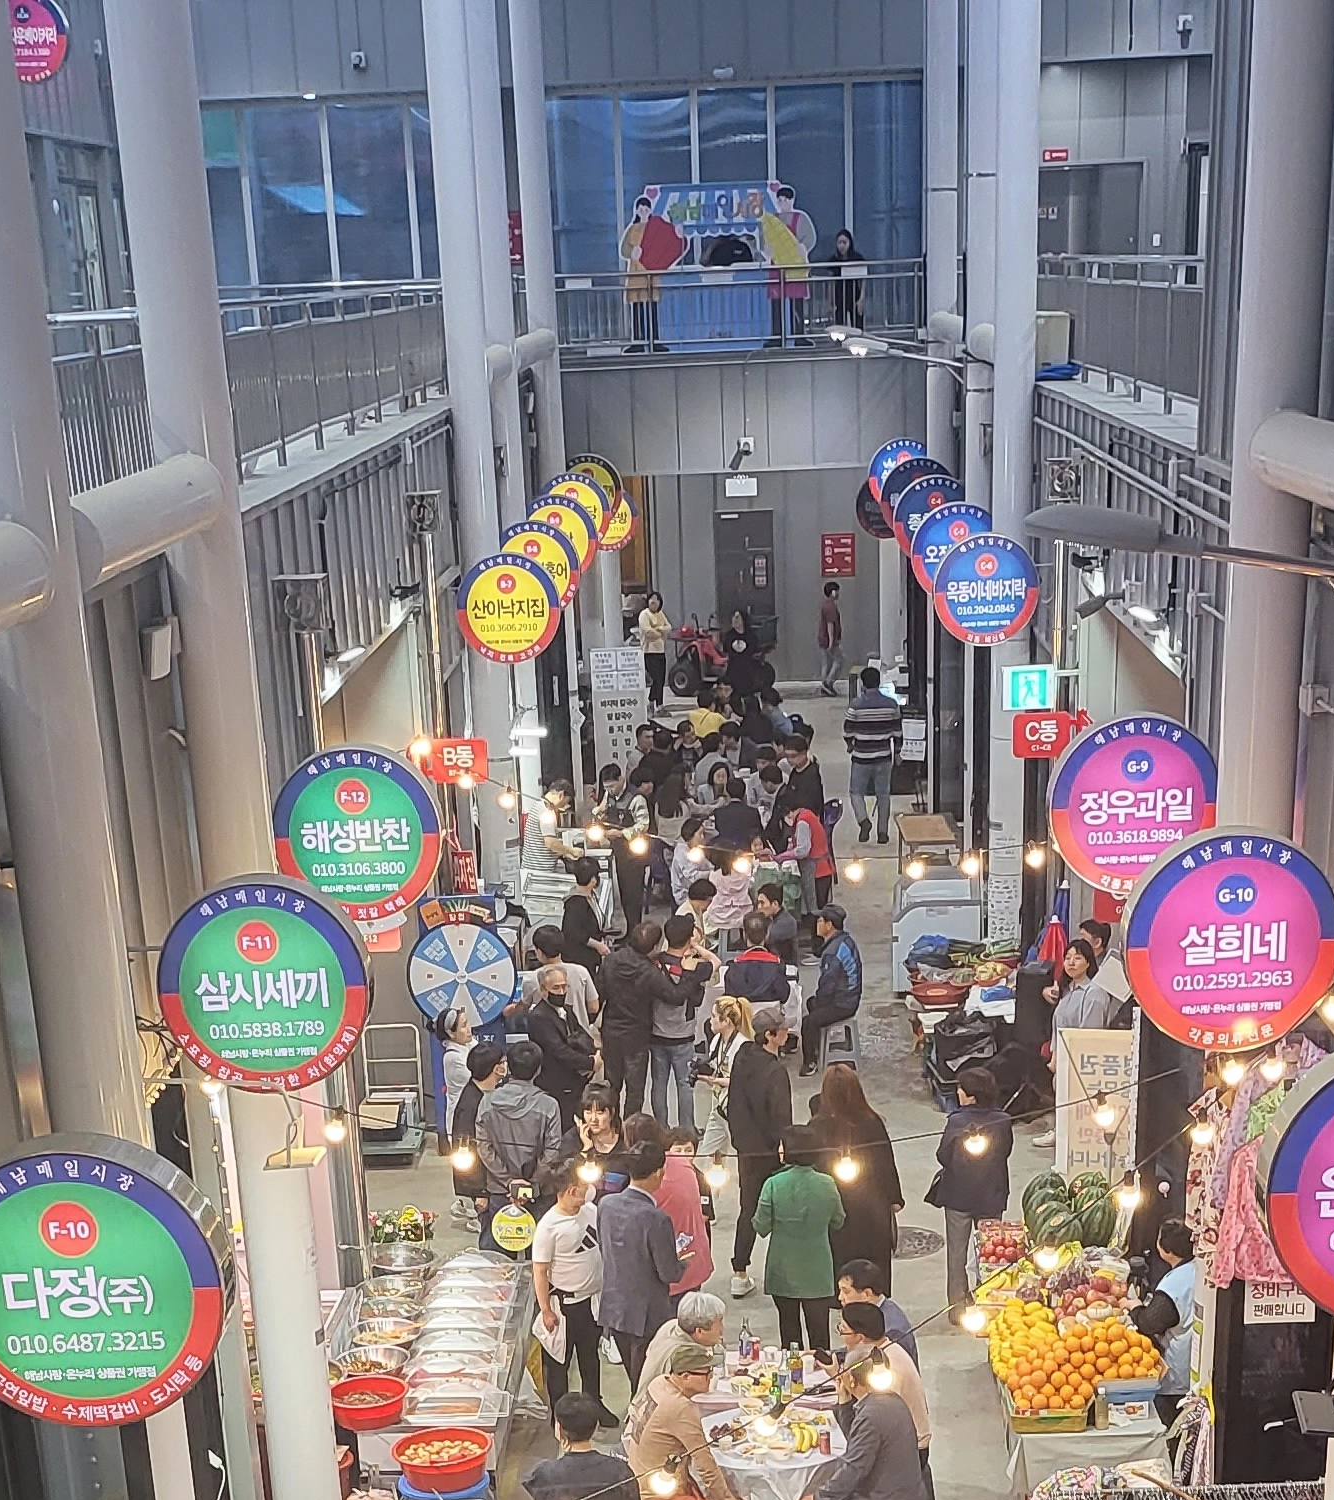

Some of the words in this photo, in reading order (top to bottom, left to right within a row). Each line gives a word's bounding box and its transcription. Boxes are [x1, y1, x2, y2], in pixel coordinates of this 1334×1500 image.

[947, 578, 1027, 603] 옥동이네바지락
[472, 598, 545, 619] 산이낙지집
[1025, 719, 1059, 742] C동
[443, 746, 475, 767] B동
[1127, 760, 1149, 773] G-9
[340, 791, 366, 804] F-12
[1079, 786, 1193, 825] 정우과일
[300, 818, 410, 854] 해성반찬
[1088, 829, 1184, 845] 010.3618.9894
[1181, 839, 1292, 870] 해남매일시장
[312, 861, 406, 877] 010.3106.3800
[199, 889, 305, 917] 해남매일시장
[1218, 888, 1254, 903] G-10
[241, 936, 272, 950] F-11
[1179, 921, 1288, 966] 설희네
[195, 968, 330, 1012] 삼시세끼
[1172, 970, 1293, 991] 010.2591.2963
[209, 1021, 325, 1040] 010.5838.1789
[48, 1221, 90, 1240] F-10
[1, 1265, 154, 1319] 다정(주)
[1253, 1303, 1305, 1317] 판매합니다
[7, 1331, 165, 1355] 010.6487.3215
[61, 1398, 141, 1422] 수제떡갈비
[148, 1370, 193, 1406] 도시락
[183, 1353, 203, 1372] 등
